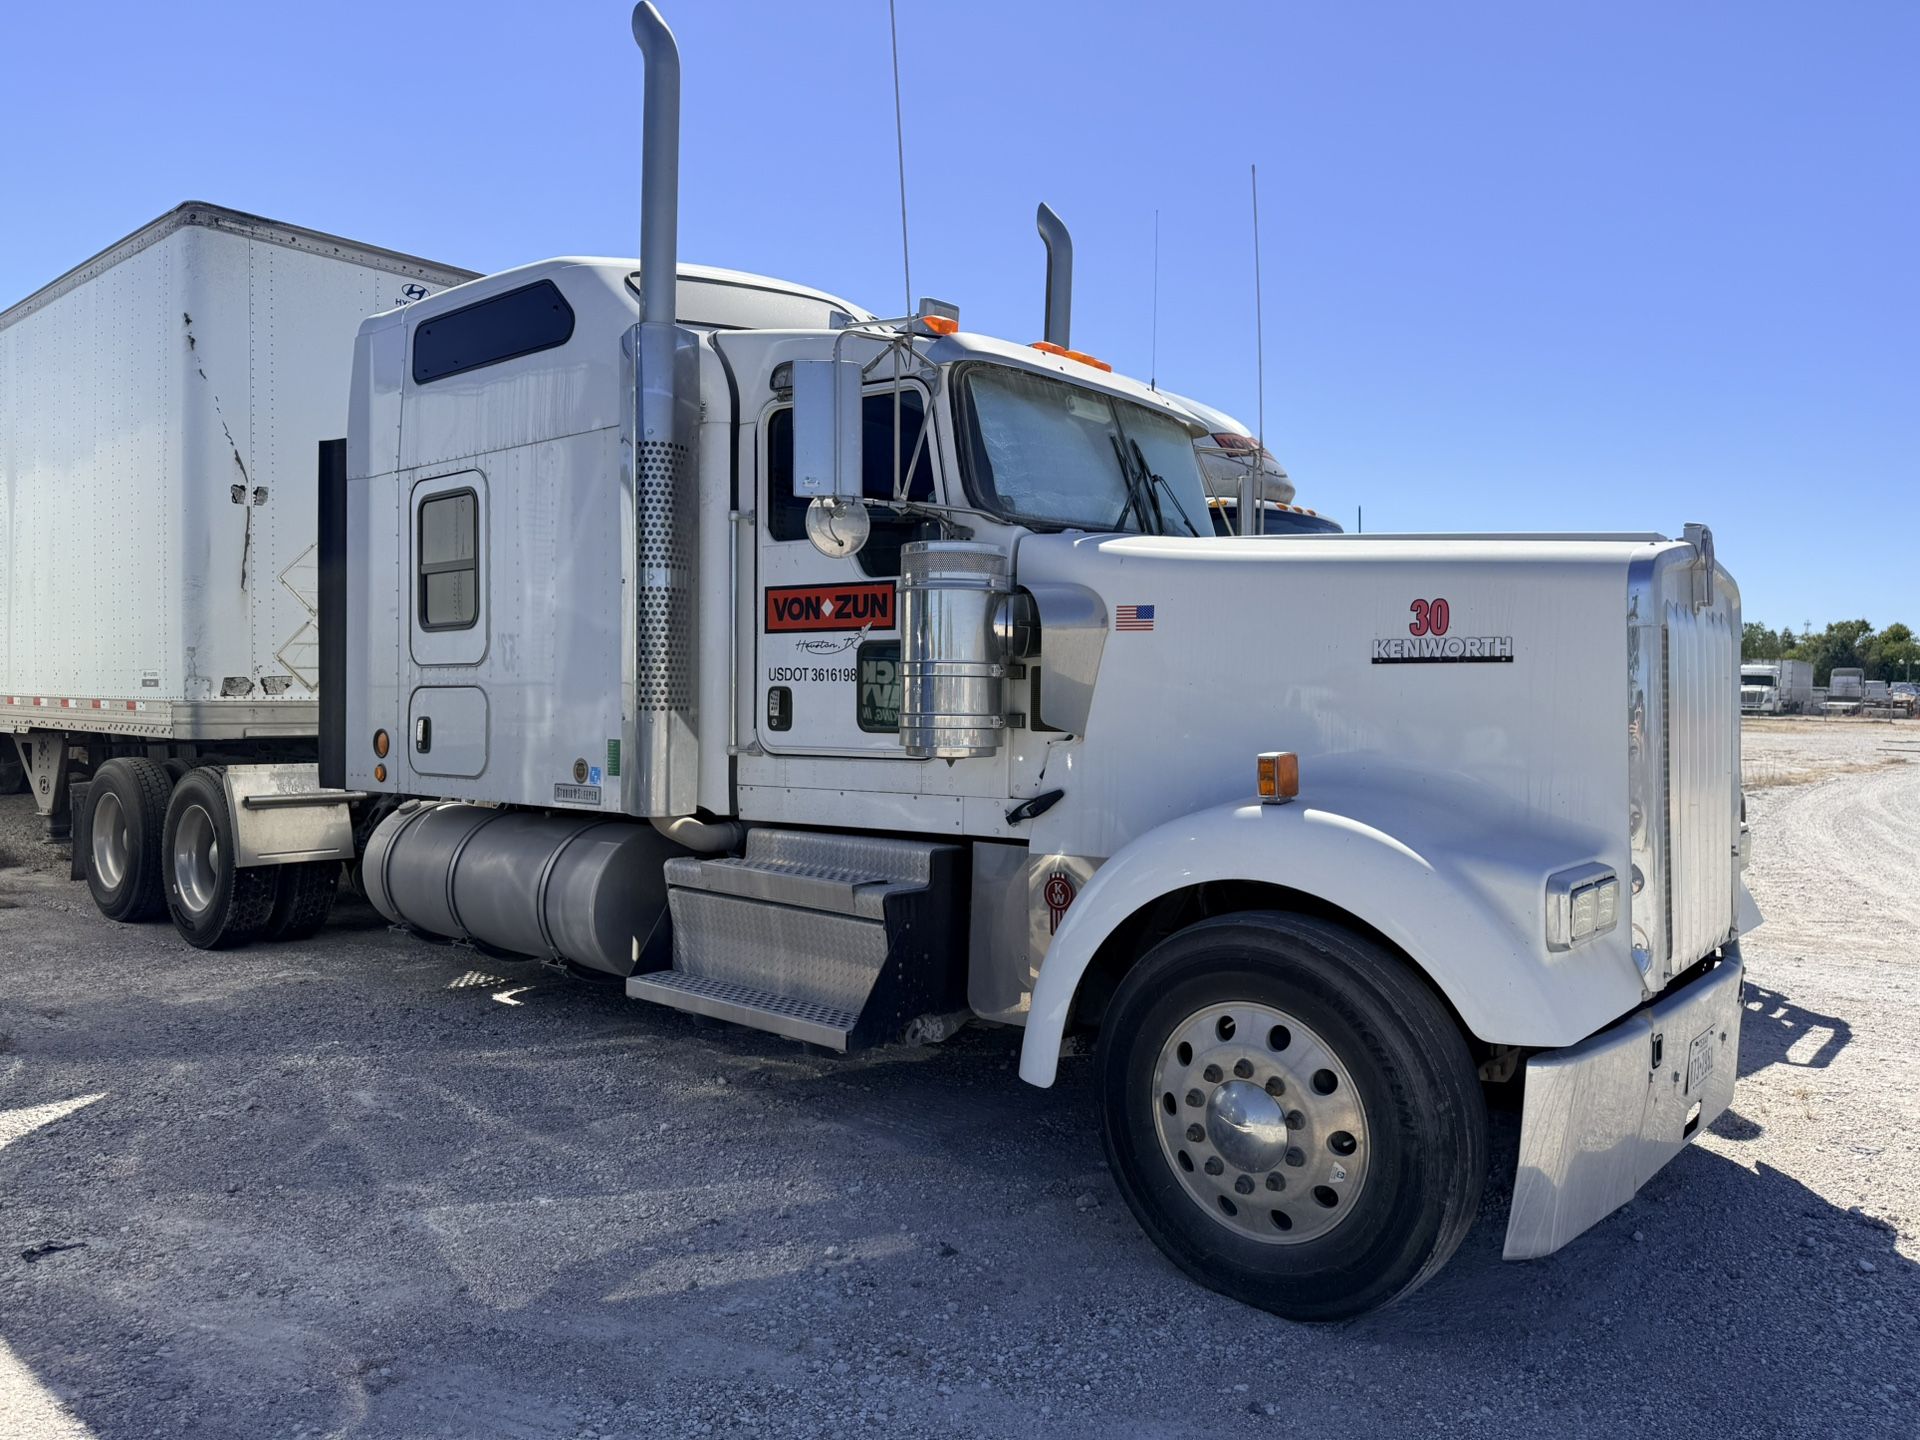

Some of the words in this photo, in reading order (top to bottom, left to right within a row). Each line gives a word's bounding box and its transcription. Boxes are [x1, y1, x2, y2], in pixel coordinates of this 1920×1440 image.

[773, 596, 820, 621] VON
[835, 593, 888, 619] ZUN
[1409, 598, 1450, 636] 30
[1373, 637, 1513, 658] KENWORTH
[769, 667, 809, 681] USDOT
[811, 667, 857, 681] 3616198
